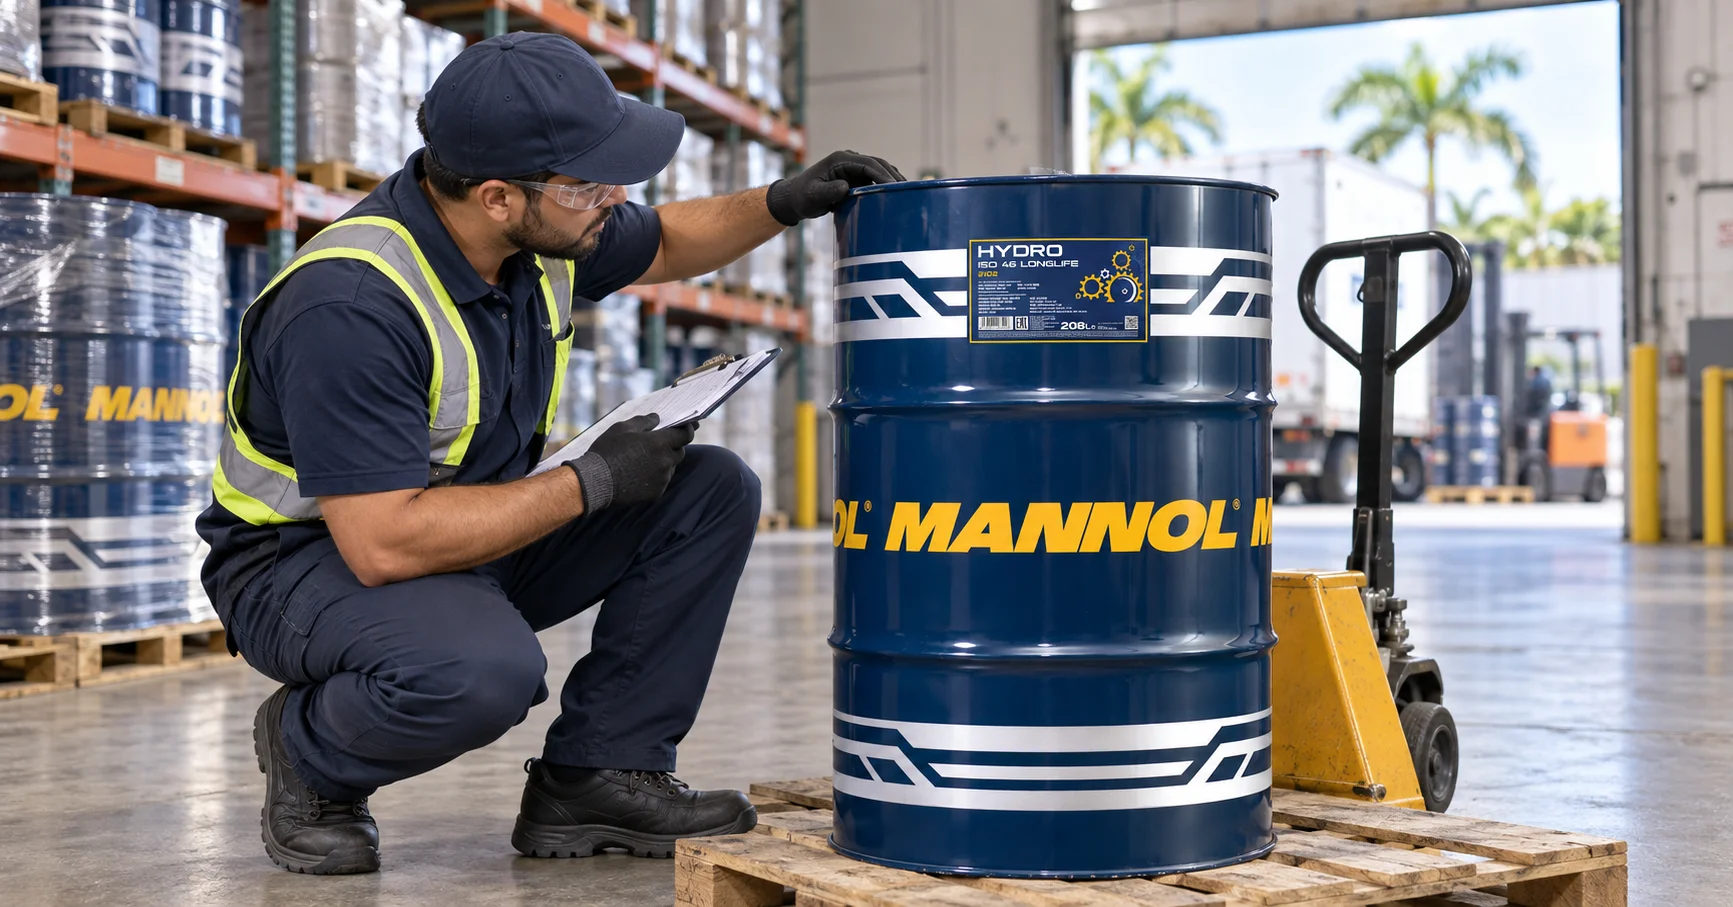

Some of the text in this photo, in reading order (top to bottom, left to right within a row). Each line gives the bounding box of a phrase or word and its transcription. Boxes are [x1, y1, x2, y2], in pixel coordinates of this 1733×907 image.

[978, 244, 1063, 258] HYDRO
[978, 261, 998, 269] ISO
[1020, 260, 1079, 268] LONGLIFE
